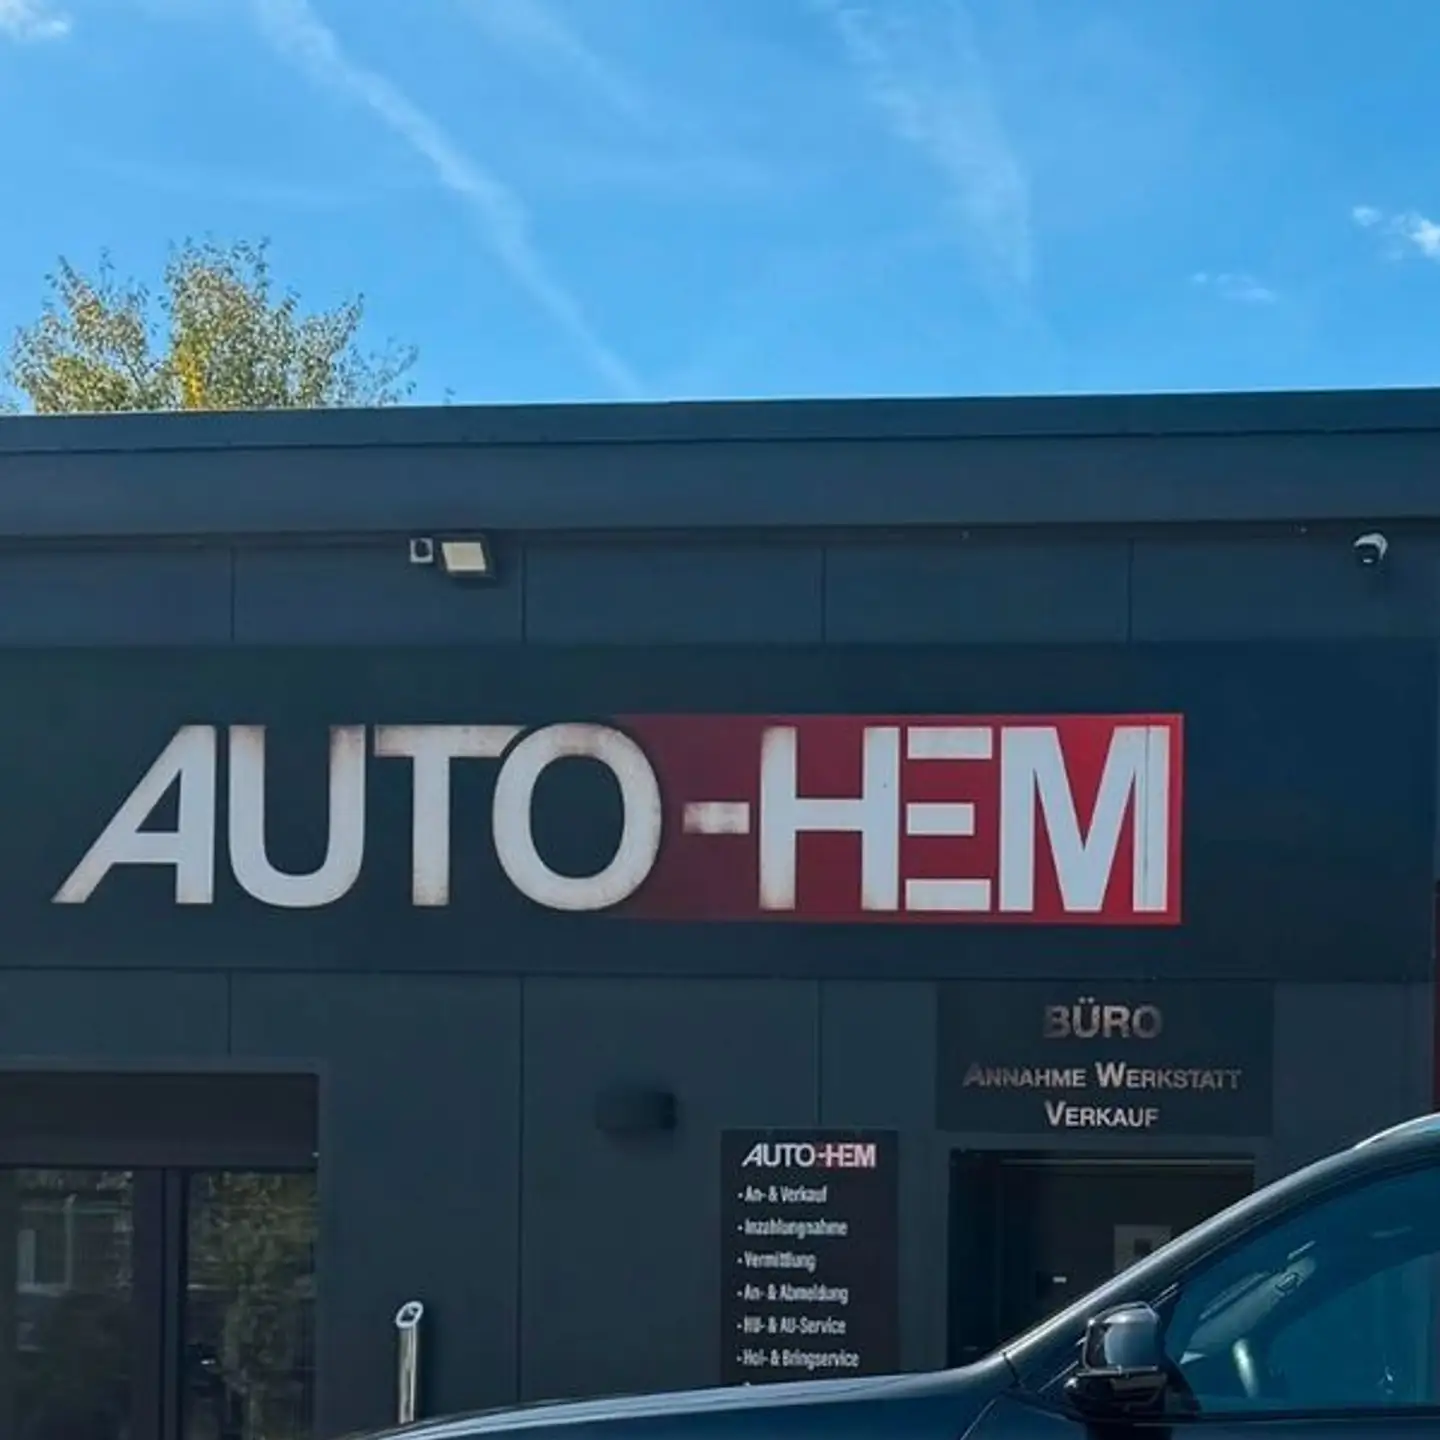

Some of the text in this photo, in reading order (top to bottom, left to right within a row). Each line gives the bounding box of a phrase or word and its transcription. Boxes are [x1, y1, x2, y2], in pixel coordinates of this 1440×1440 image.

[51, 720, 1170, 914] AUTO-HEM
[1044, 996, 1161, 1038] BÜRO
[962, 1061, 1242, 1090] ANNAHME WERKSTATT
[1044, 1100, 1159, 1127] VERKAUF
[741, 1142, 877, 1168] AUTO-HEM
[768, 1185, 777, 1202] &
[780, 1185, 828, 1203] Verkauf
[744, 1218, 848, 1239] Inzahlungnahme
[744, 1251, 817, 1273] Vermittlung
[767, 1284, 776, 1301] &
[780, 1283, 849, 1305] Abmeldung
[767, 1316, 777, 1333] &
[780, 1315, 846, 1334] AU-Service
[770, 1349, 780, 1366] &
[782, 1348, 860, 1370] Bringservice
